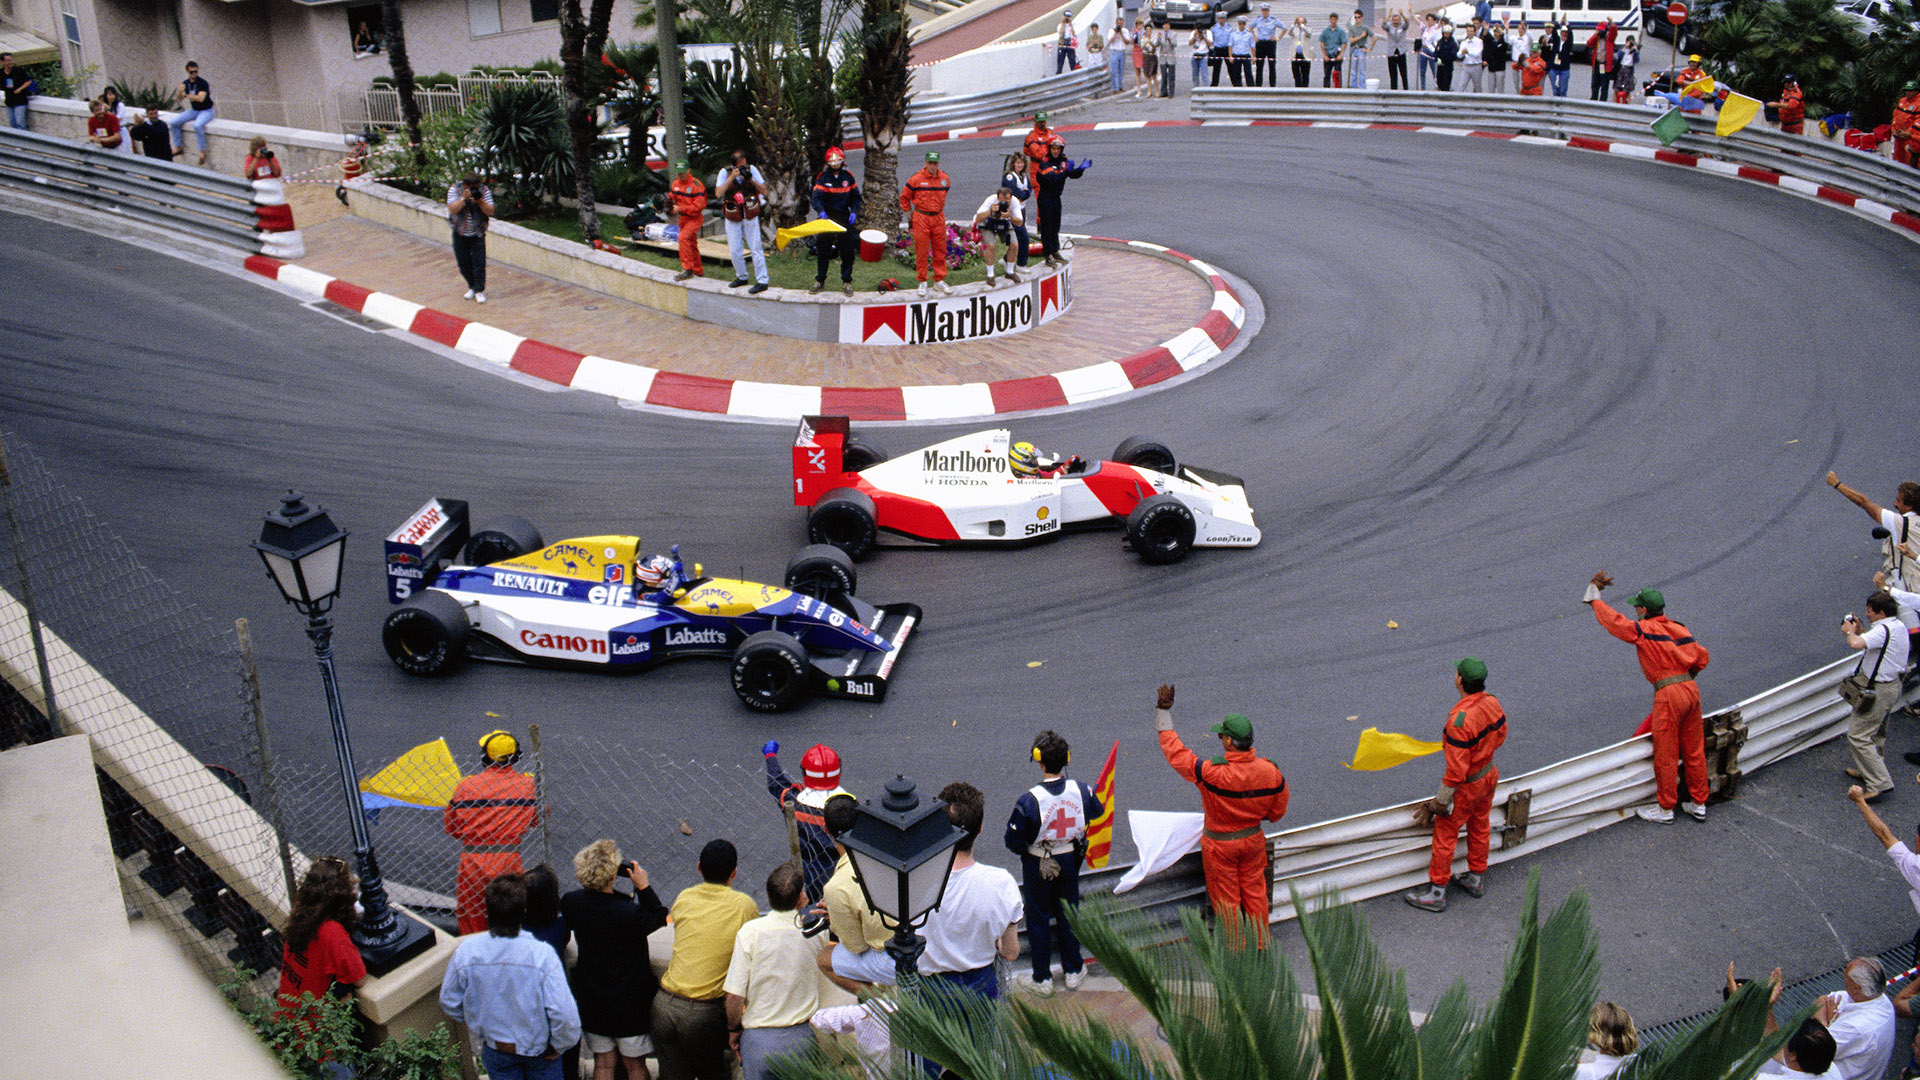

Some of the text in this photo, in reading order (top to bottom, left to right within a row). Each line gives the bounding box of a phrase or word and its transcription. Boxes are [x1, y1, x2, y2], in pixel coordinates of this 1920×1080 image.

[910, 294, 1032, 345] Marlboro
[923, 450, 1006, 473] Marlboro
[795, 478, 804, 493] 1
[1025, 518, 1057, 535] Shell
[543, 544, 596, 567] CAMEL
[388, 564, 423, 578] Labatt's
[395, 577, 411, 599] 5
[492, 572, 569, 596] RENAULT
[588, 585, 632, 607] elf
[690, 588, 735, 605] CAMEL
[828, 608, 848, 627] el
[849, 619, 870, 635] 5
[520, 629, 607, 655] Canon
[665, 626, 727, 645] Labatt's
[612, 640, 650, 655] Labatt's
[847, 681, 875, 696] Bull
